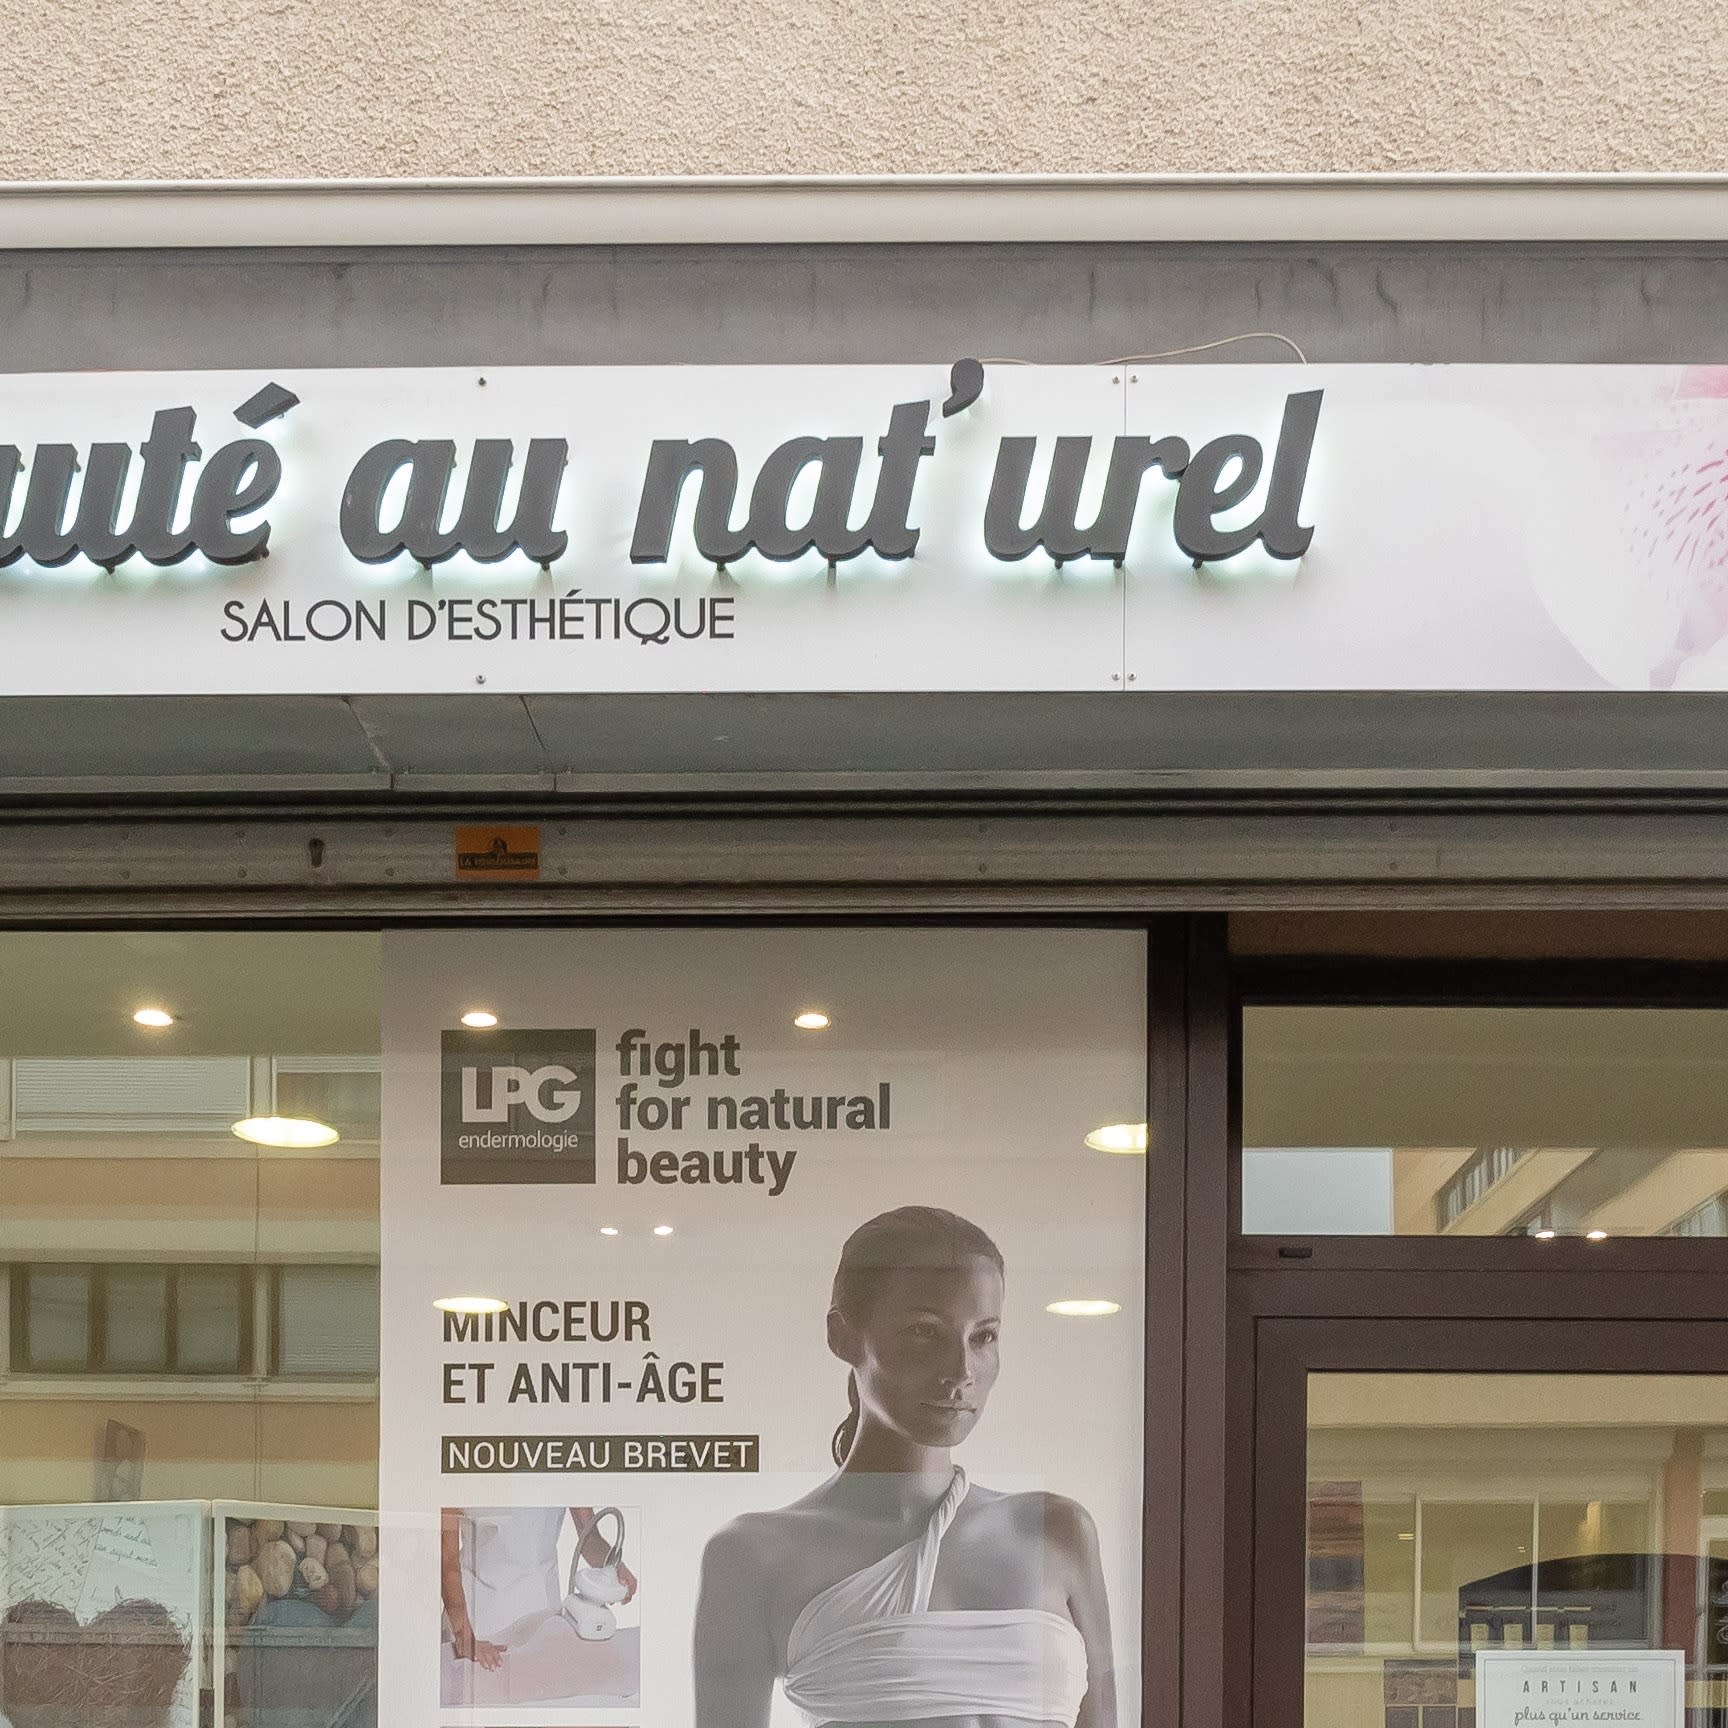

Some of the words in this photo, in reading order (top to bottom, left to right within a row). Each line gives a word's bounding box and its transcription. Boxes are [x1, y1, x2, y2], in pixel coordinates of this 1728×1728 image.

[340, 437, 569, 565] au
[221, 598, 385, 641] SALON
[408, 585, 739, 645] D'ESTHÉTIQUE
[616, 1028, 741, 1088] fight
[461, 1065, 581, 1123] LPG
[616, 1083, 691, 1130] for
[708, 1083, 890, 1130] natural
[458, 1131, 579, 1152] endermologie
[618, 1138, 797, 1197] beauty
[443, 1301, 651, 1341] MINCEUR
[443, 1363, 495, 1402] ET
[508, 1353, 724, 1403] ANTI-ÂGE
[449, 1442, 610, 1469] NOUVEAU
[625, 1442, 753, 1469] BREVET
[1523, 1680, 1637, 1693] ARTISAN
[1515, 1706, 1545, 1726] plus
[1549, 1707, 1589, 1726] qu'un
